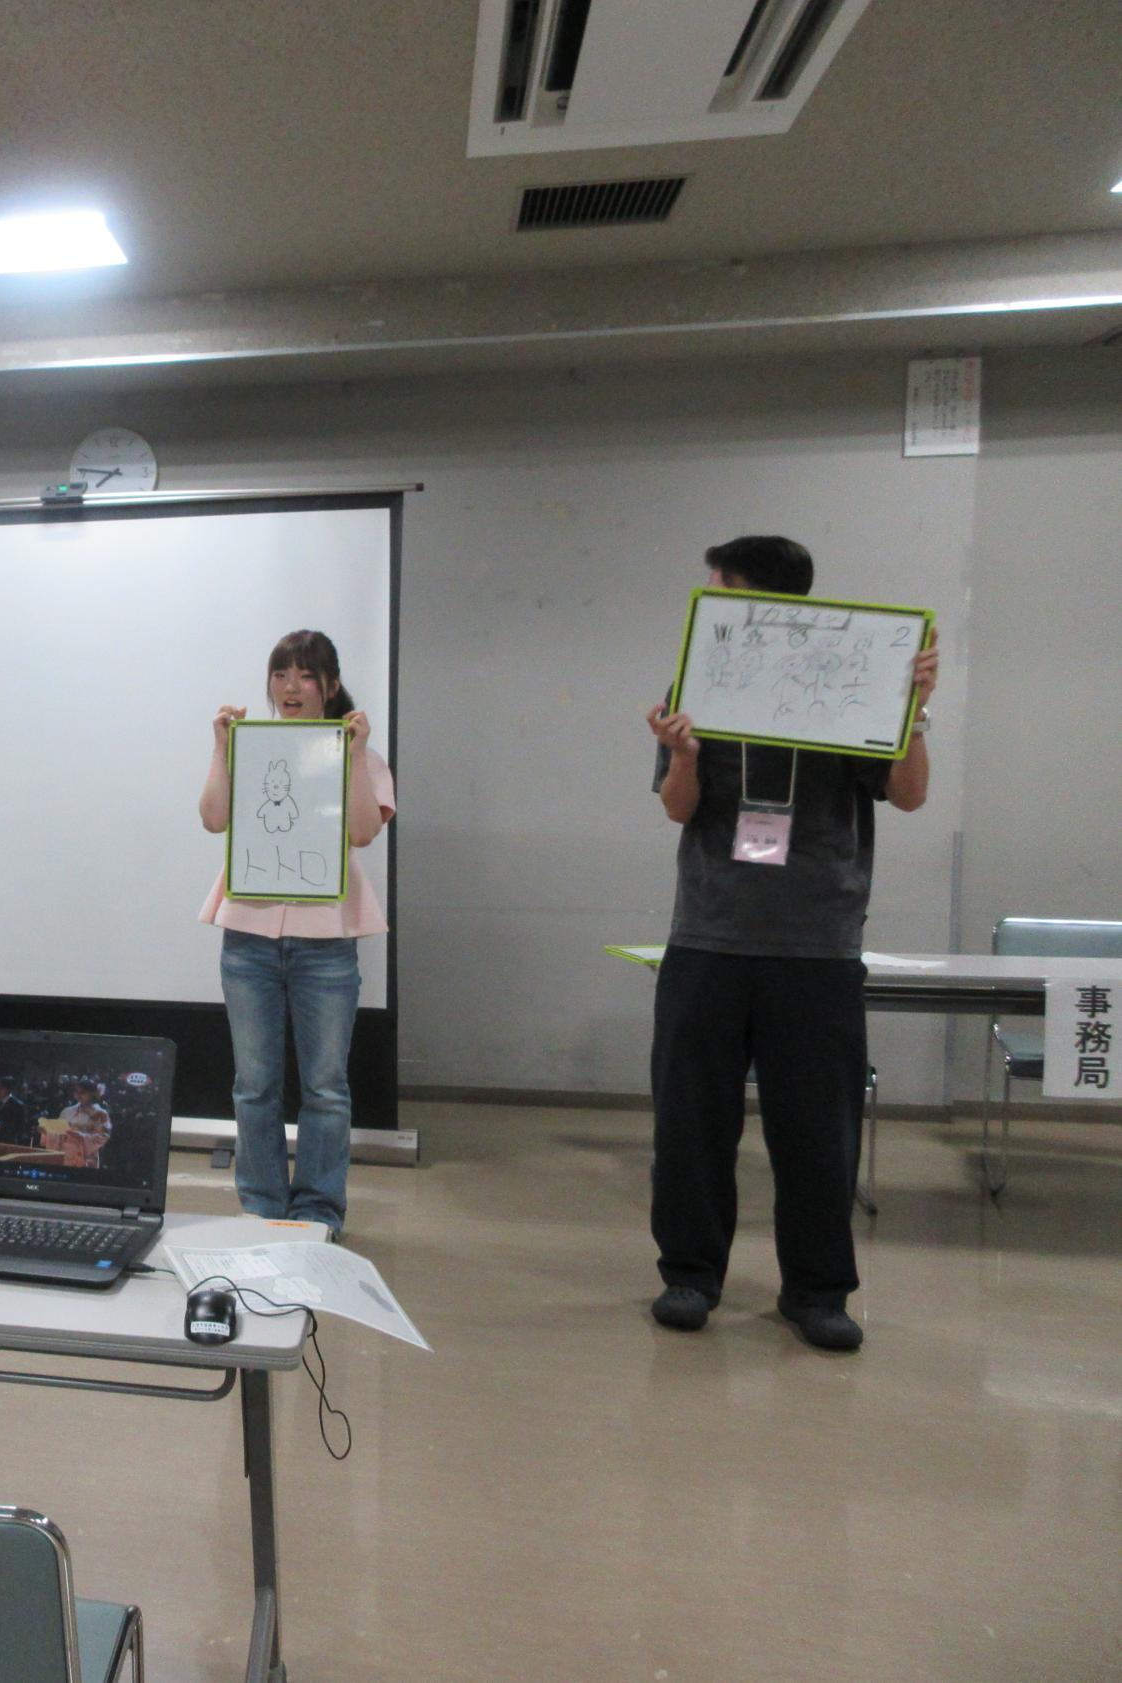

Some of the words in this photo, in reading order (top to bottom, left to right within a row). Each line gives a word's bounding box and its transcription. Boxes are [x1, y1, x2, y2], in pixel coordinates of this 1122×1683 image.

[889, 626, 912, 647] 2
[1073, 985, 1113, 1089] 事務局
